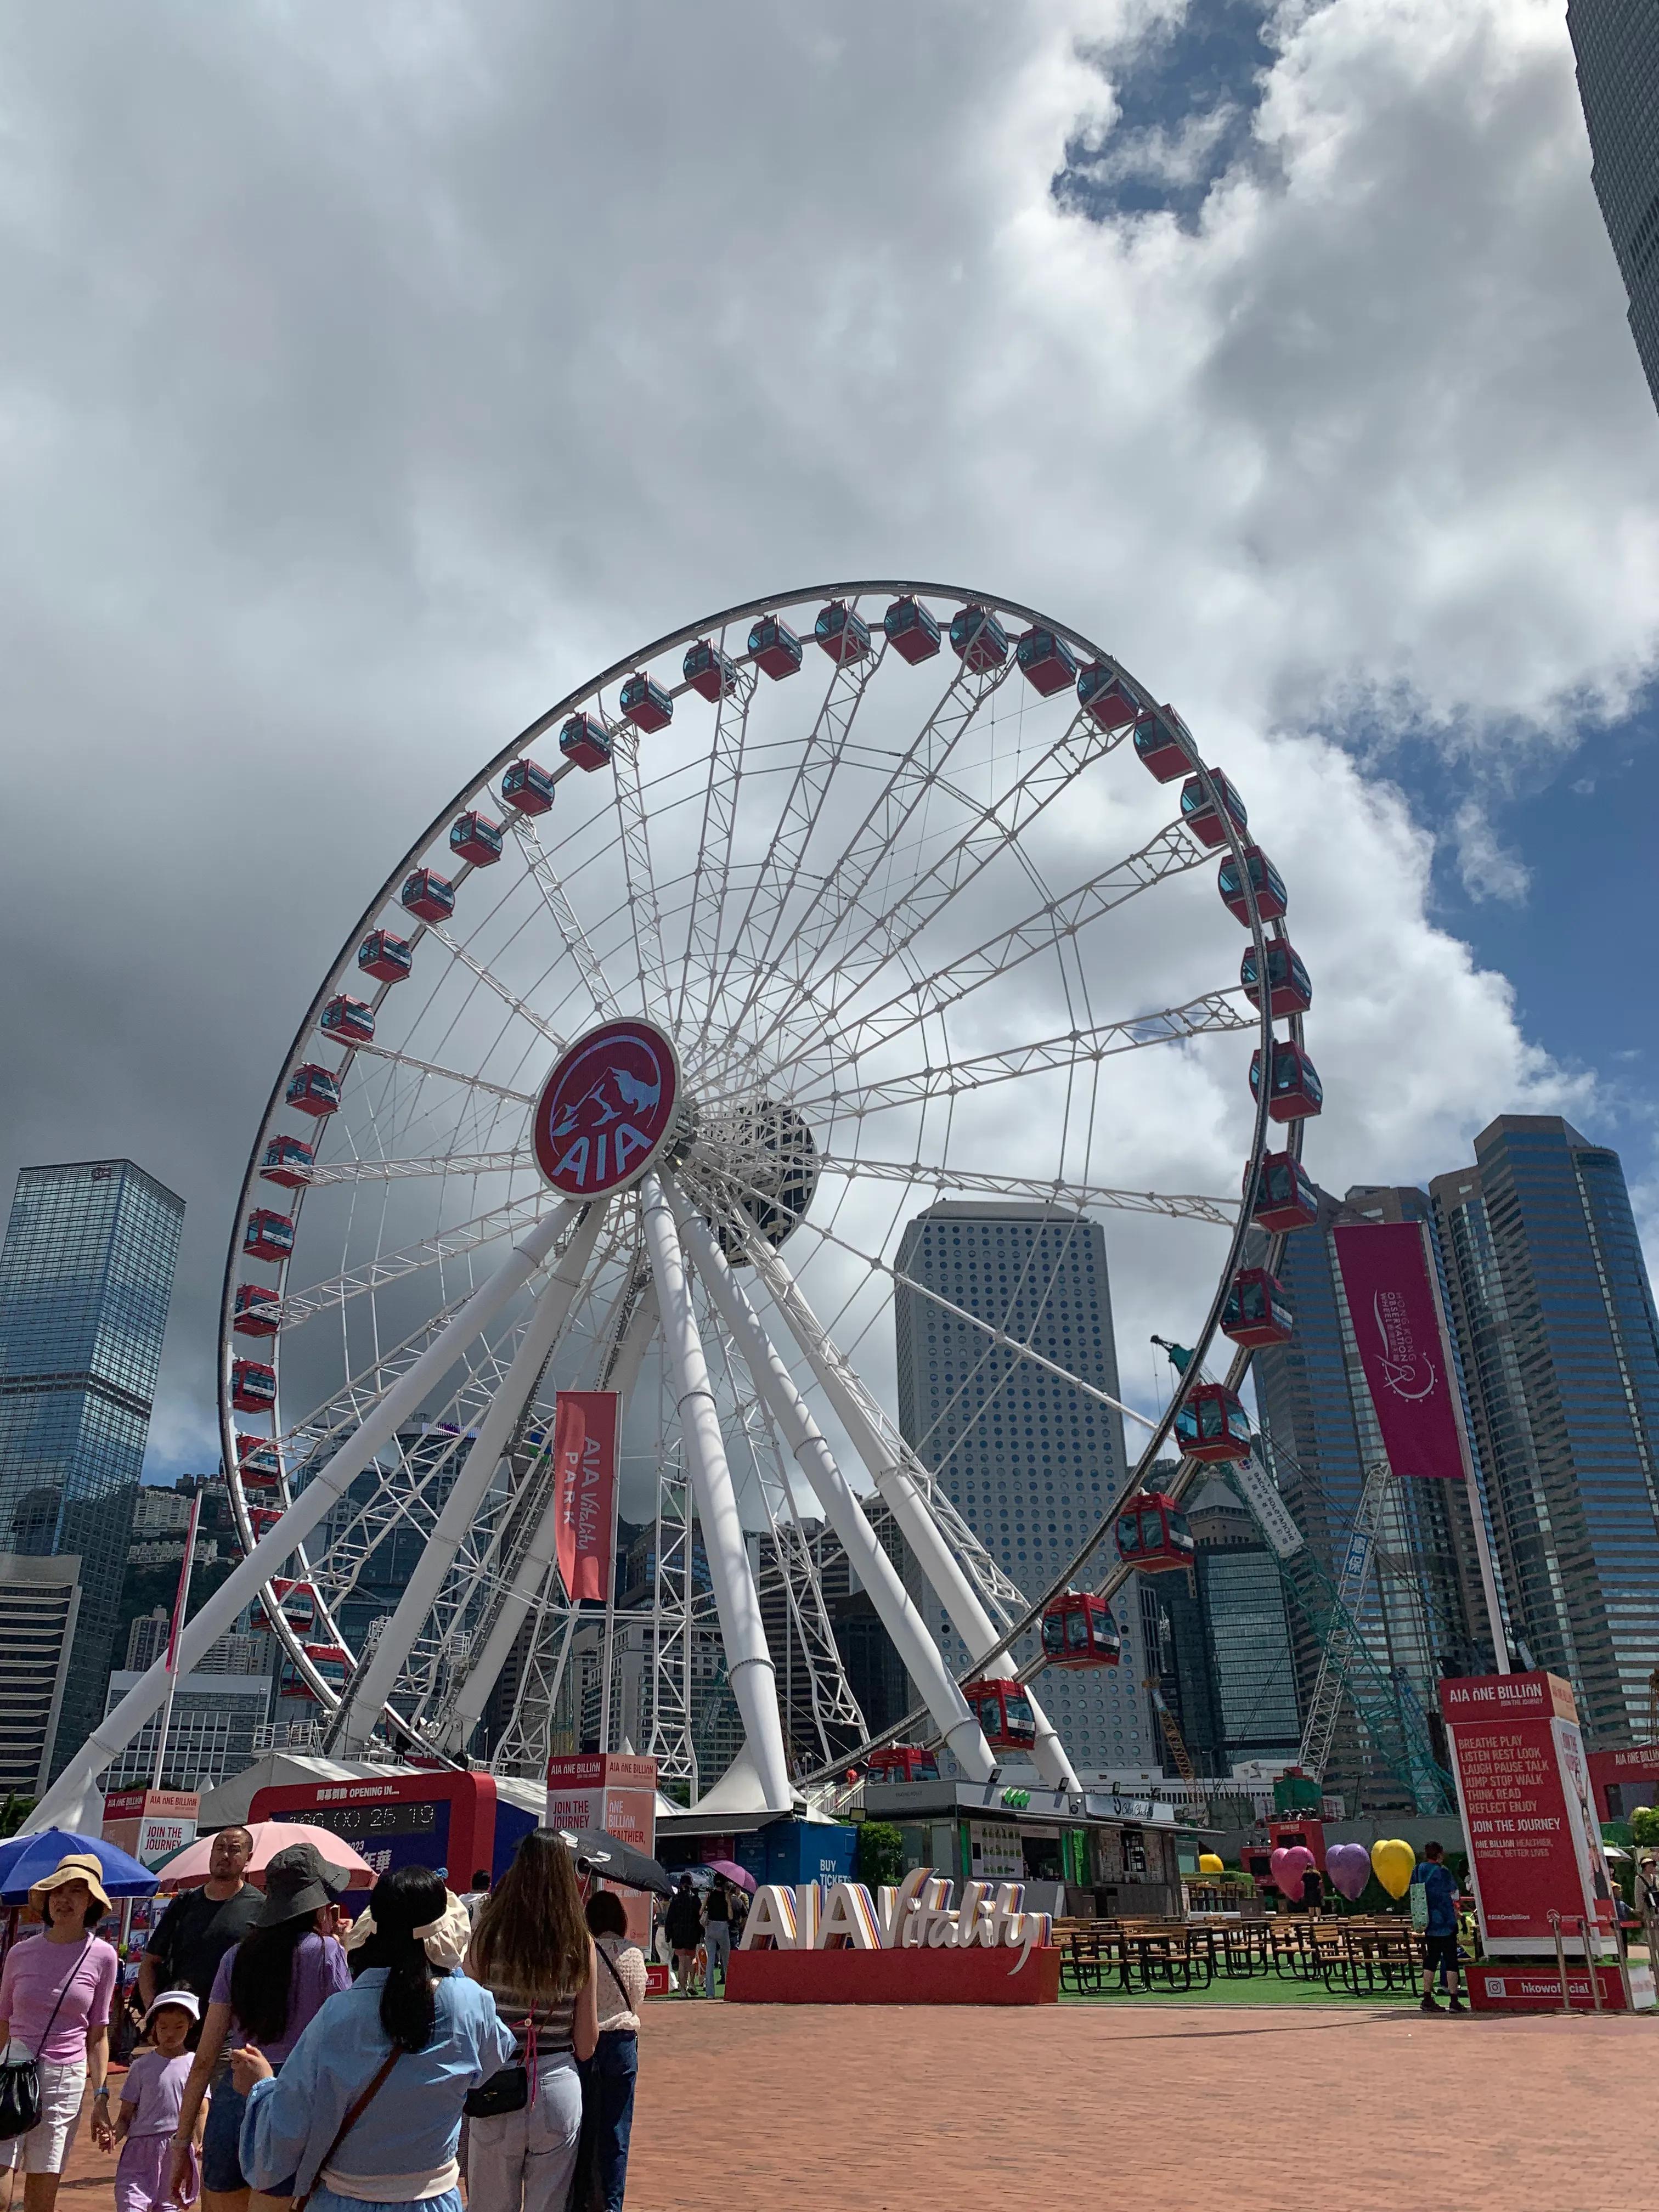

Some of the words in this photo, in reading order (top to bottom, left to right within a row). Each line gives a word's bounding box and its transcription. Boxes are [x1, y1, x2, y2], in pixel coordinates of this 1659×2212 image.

[551, 1123, 654, 1187] AIA
[1387, 1292, 1408, 1362] OBSERVATION
[1396, 1293, 1409, 1325] HONG
[1404, 1328, 1417, 1361] KONG
[580, 1436, 601, 1487] AIA
[563, 1452, 579, 1525] PARK
[575, 1492, 601, 1550] Vitality
[1450, 1689, 1470, 1703] AIA
[1458, 1736, 1498, 1750] BREATHE
[1500, 1735, 1522, 1747] PLAY
[1460, 1750, 1491, 1762] LISTEN
[1492, 1748, 1515, 1760] REST
[1517, 1747, 1542, 1759] LOOK
[551, 1764, 562, 1776] AIA
[609, 1762, 620, 1773] AIA
[1463, 1763, 1492, 1775] LAUGH
[1494, 1761, 1524, 1774] PAUSE
[1525, 1759, 1550, 1771] TALK
[1465, 1776, 1488, 1788] JUMP
[1490, 1775, 1513, 1787] STOP
[1515, 1774, 1544, 1786] WALK
[349, 1786, 383, 1798] OPENING
[1466, 1789, 1495, 1801] THINK
[1496, 1788, 1521, 1799] READ
[107, 1798, 116, 1808] AIA
[150, 1796, 161, 1804] AIA
[1469, 1801, 1506, 1814] REFLECT
[1509, 1800, 1537, 1812] ENJOY
[553, 1801, 571, 1815] JOIN
[572, 1800, 590, 1814] THE
[553, 1815, 590, 1829] JOURNEY
[1472, 1820, 1493, 1833] JOIN
[1494, 1819, 1515, 1832] THE
[1517, 1817, 1561, 1831] JOURNEY
[147, 1826, 165, 1837] JOIN
[168, 1827, 183, 1838] THE
[145, 1840, 182, 1851] JOURNEY
[360, 1849, 392, 1872] 年華
[820, 1859, 837, 1872] BUY
[820, 1874, 852, 1887] TICKETS
[739, 1884, 881, 1950] AIA
[878, 1867, 1052, 1976] Vitality
[1521, 1982, 1589, 1994] hkowofcial
